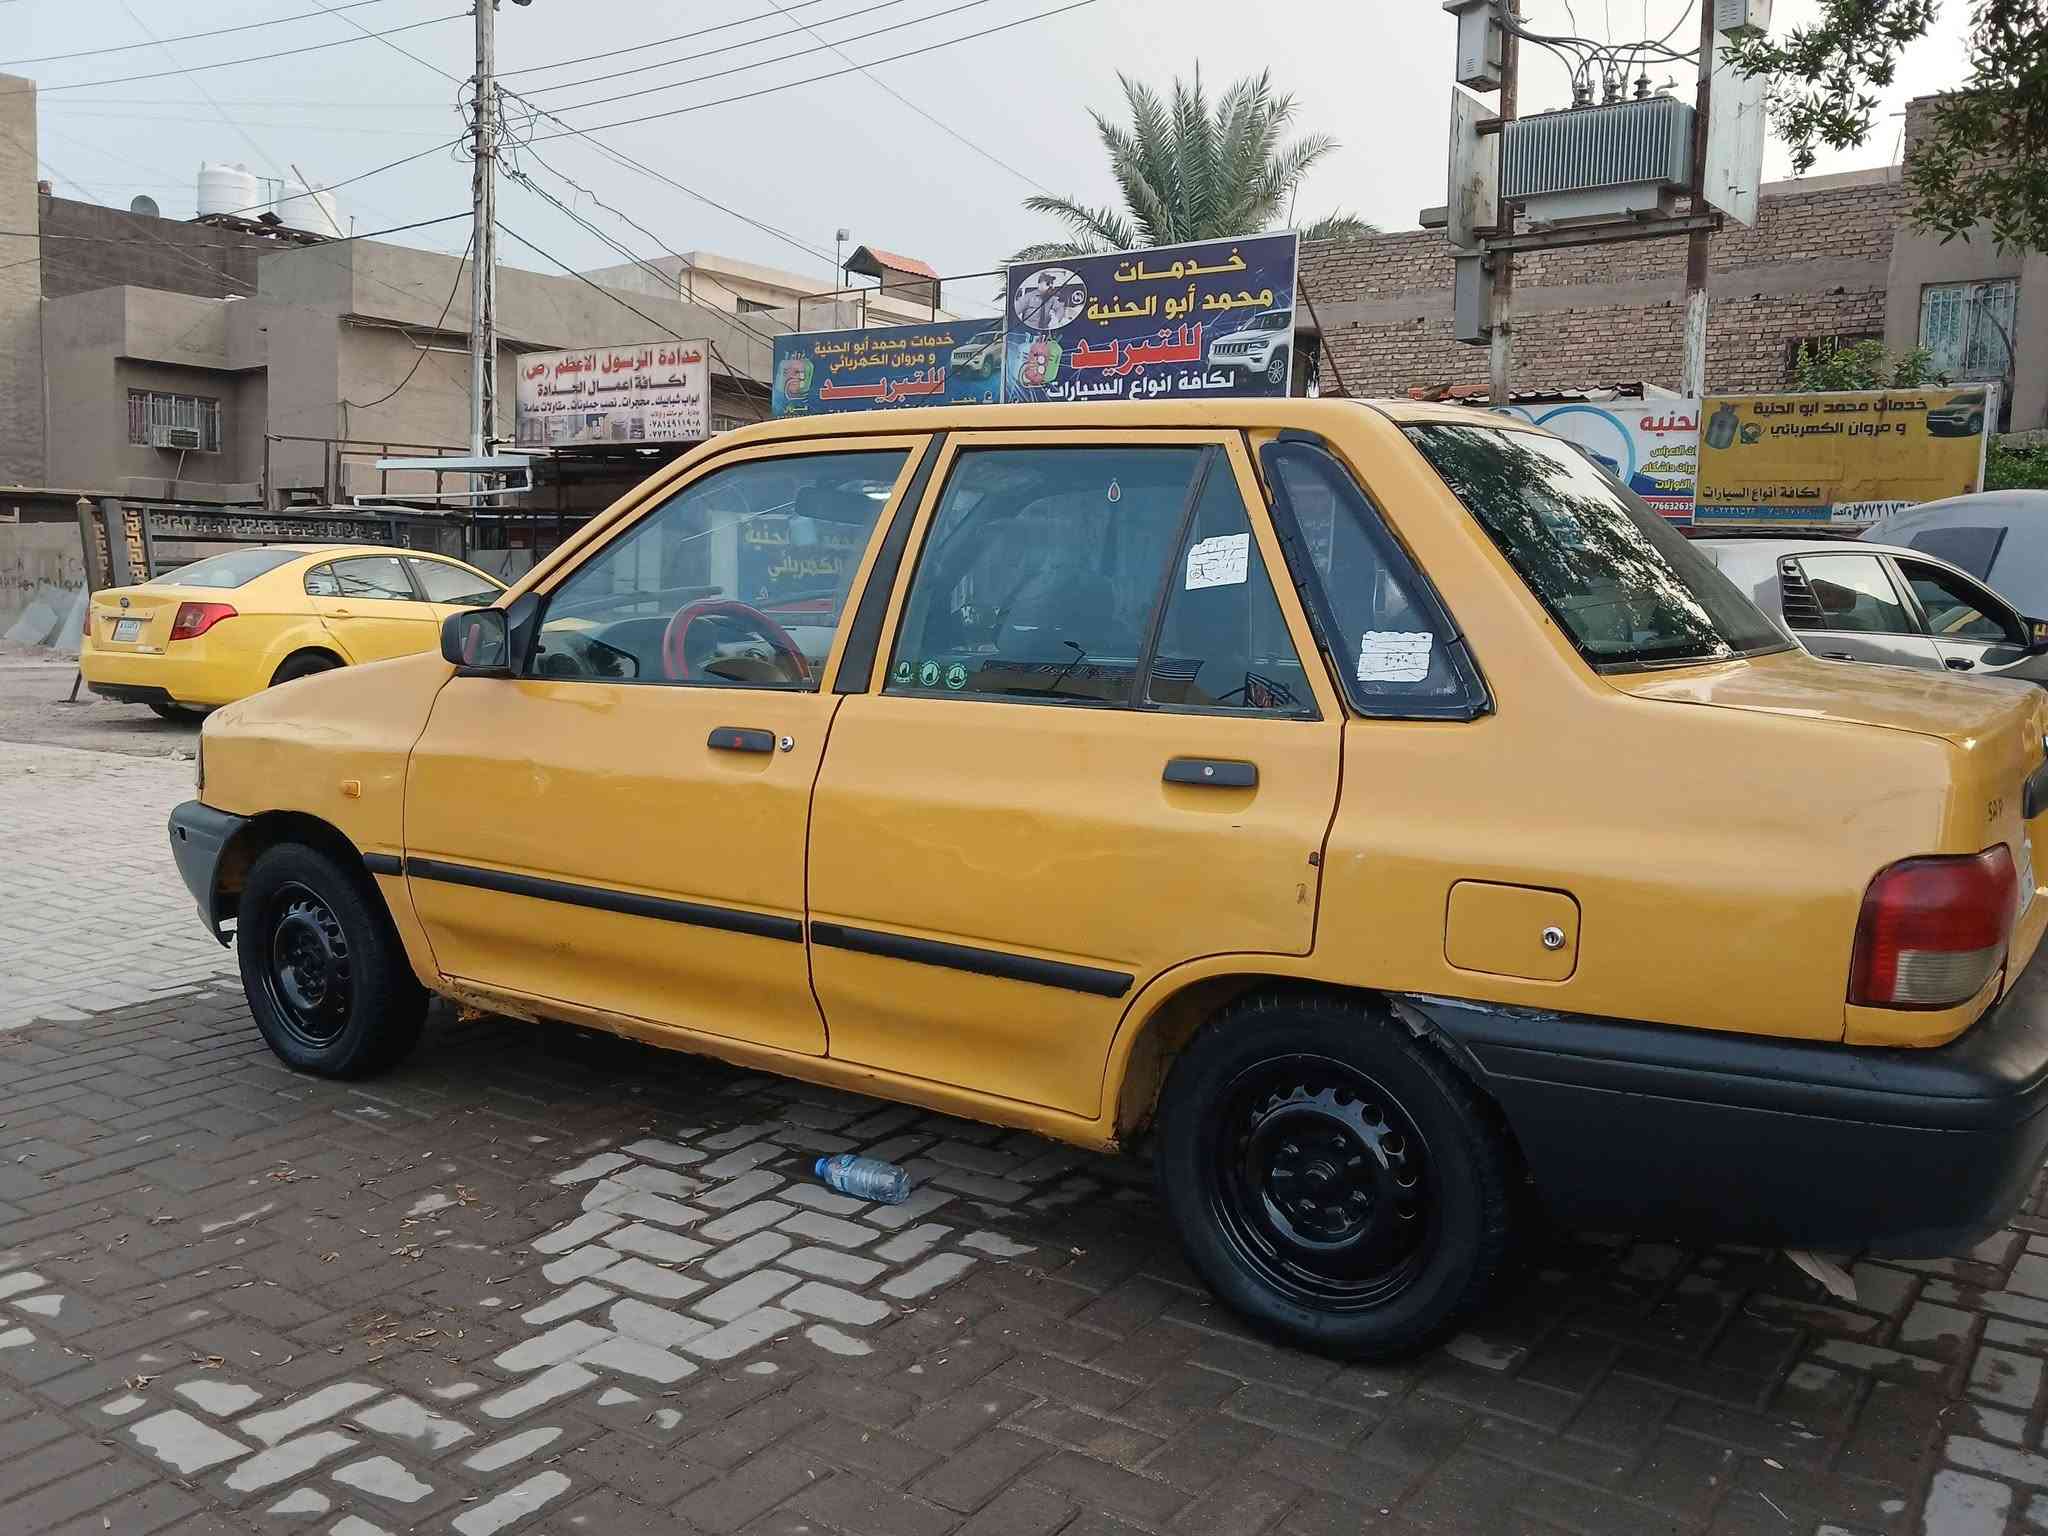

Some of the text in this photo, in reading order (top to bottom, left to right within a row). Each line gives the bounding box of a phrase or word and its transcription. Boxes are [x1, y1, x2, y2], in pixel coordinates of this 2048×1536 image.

[1114, 248, 1247, 282] خدمات
[1087, 284, 1274, 326] محمد أبو الحنية
[872, 339, 906, 351] محمد
[911, 332, 954, 347] خدمات
[658, 347, 701, 365] حدادة
[814, 341, 850, 357] الحنية
[1071, 321, 1203, 376] للتبريد
[602, 350, 652, 373] الرسول
[830, 352, 936, 373] و مروان الكهربائي
[537, 382, 586, 398] الحدادة
[636, 374, 687, 390] لكافة
[819, 366, 946, 404] للتبريد
[1047, 370, 1235, 402] لكافة انواع السيارات
[1823, 402, 1869, 415] محمد
[1874, 398, 1927, 412] خدمات
[1640, 410, 1699, 437] لحنيه
[1848, 421, 1891, 437] مروان
[1895, 422, 1906, 436] و
[1703, 486, 1749, 501] السيارات
[1780, 486, 1820, 498] لكافة
